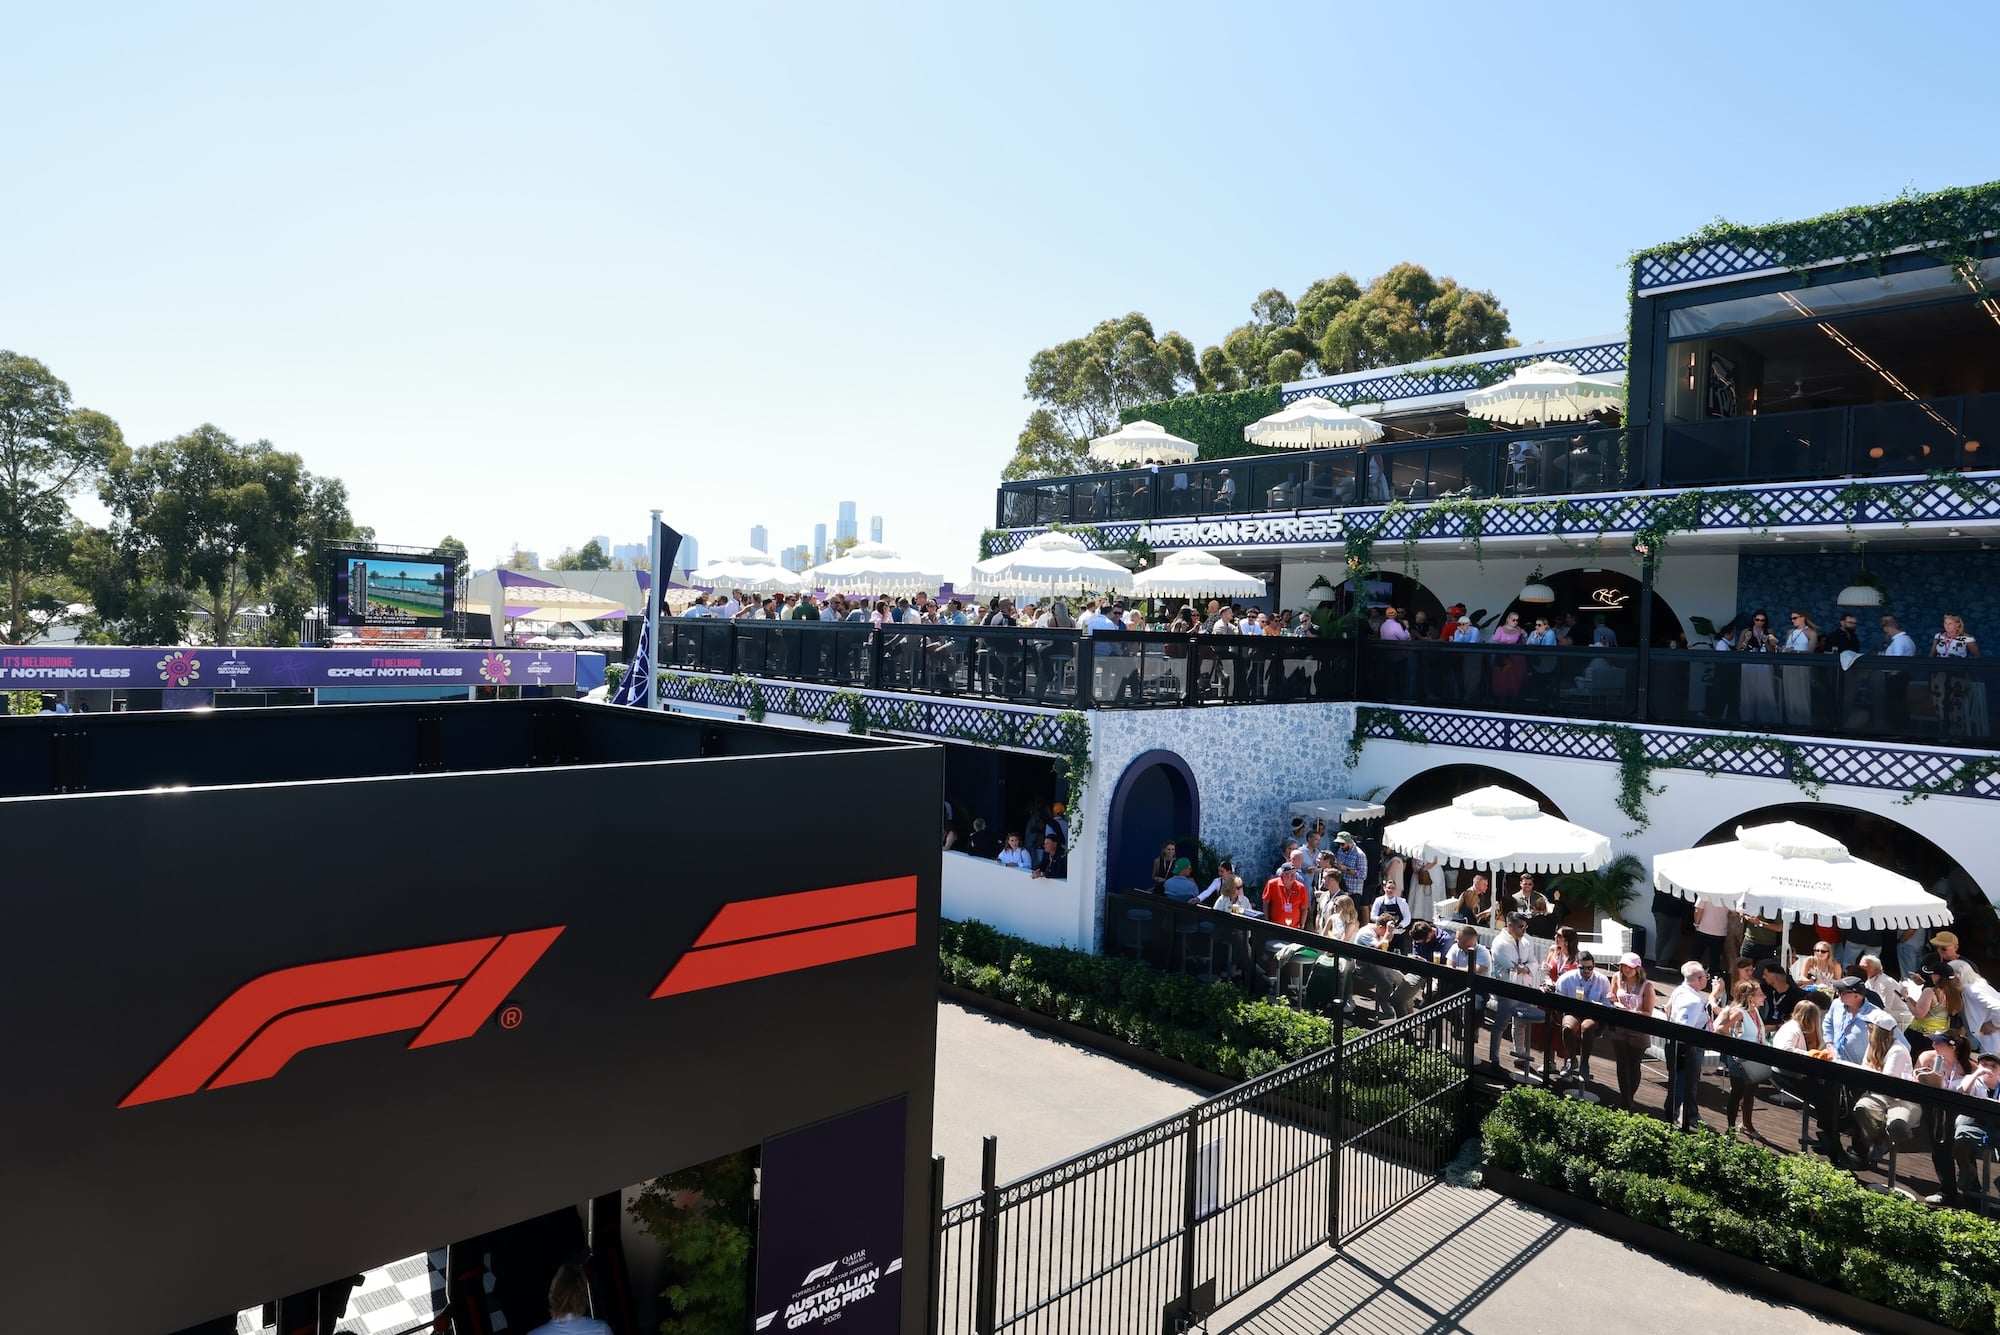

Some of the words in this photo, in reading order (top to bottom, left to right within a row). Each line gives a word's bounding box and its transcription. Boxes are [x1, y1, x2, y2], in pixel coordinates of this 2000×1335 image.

[1137, 521, 1239, 542] AMERICAN
[1243, 515, 1344, 539] EXPRESS
[3, 657, 19, 667] IT'S
[22, 657, 73, 667] MELBOURNE
[372, 659, 384, 667] IT'S
[385, 659, 421, 667] MELBOURNE
[11, 668, 88, 678] NOTHING
[90, 668, 131, 678] LESS
[328, 668, 375, 677] EXPECT
[377, 668, 431, 676] NOTHING
[433, 668, 463, 676] LESS
[1771, 876, 1832, 887] AMERICAN
[842, 1249, 866, 1265] QATAR
[792, 1284, 821, 1299] FORMULA
[830, 1272, 848, 1284] QATAR
[849, 1261, 873, 1275] AIRWAYS
[784, 1267, 880, 1319] AUSTRALIAN
[787, 1297, 841, 1330] GRAND
[842, 1281, 876, 1307] PRIX
[823, 1312, 842, 1325] 2026
